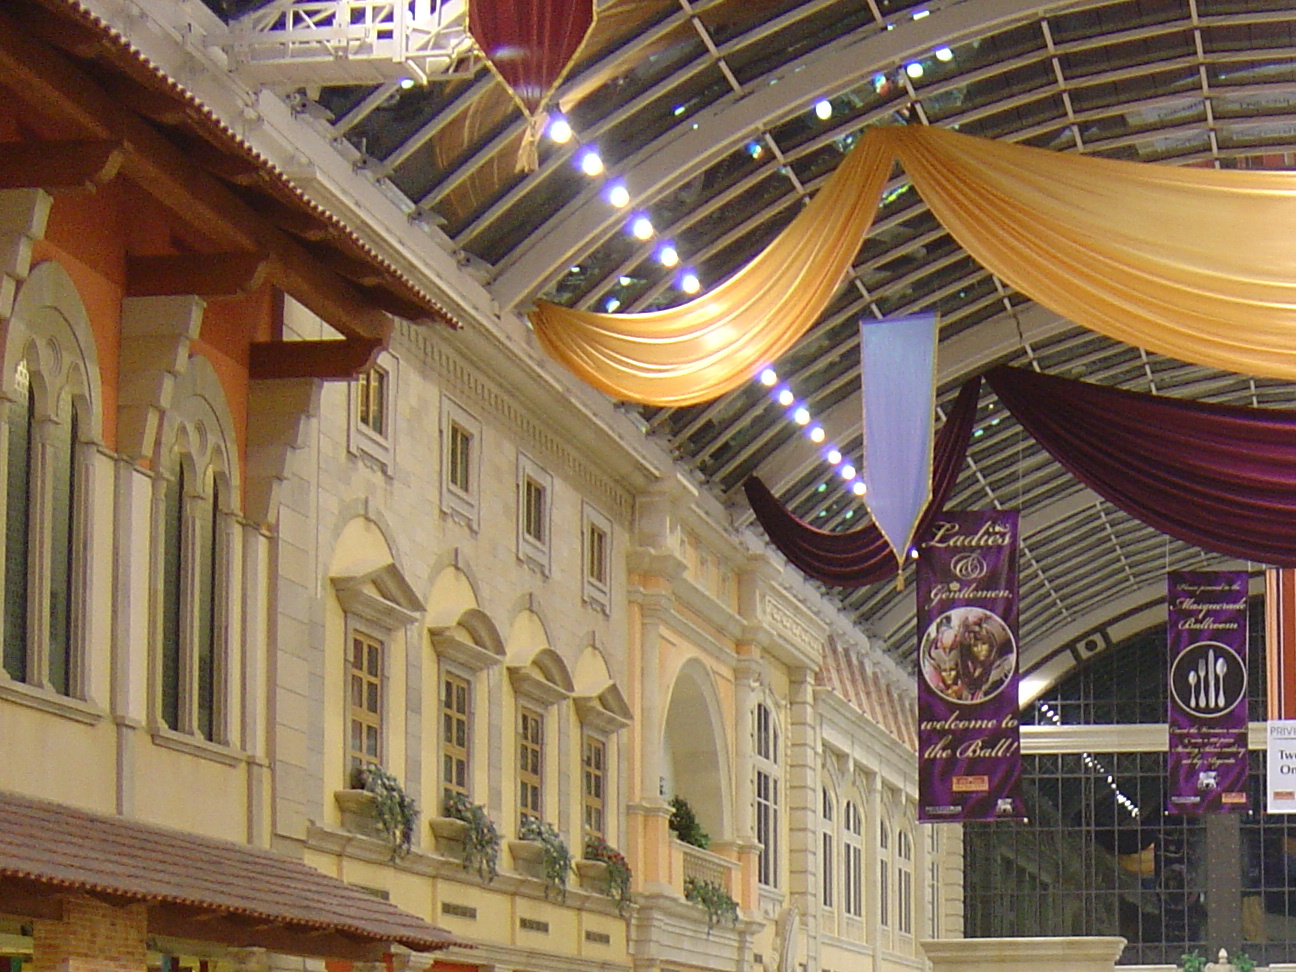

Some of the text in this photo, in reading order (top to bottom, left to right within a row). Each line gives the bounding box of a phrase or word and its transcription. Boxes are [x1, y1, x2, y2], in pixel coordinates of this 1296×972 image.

[922, 520, 1011, 548] Ladies
[951, 550, 987, 579] &
[925, 583, 1012, 610] Gentlemen,
[1170, 597, 1247, 619] Masquerade
[1178, 617, 1239, 630] Ballroom
[920, 709, 1019, 730] welcome to
[923, 734, 1019, 759] the Ball!
